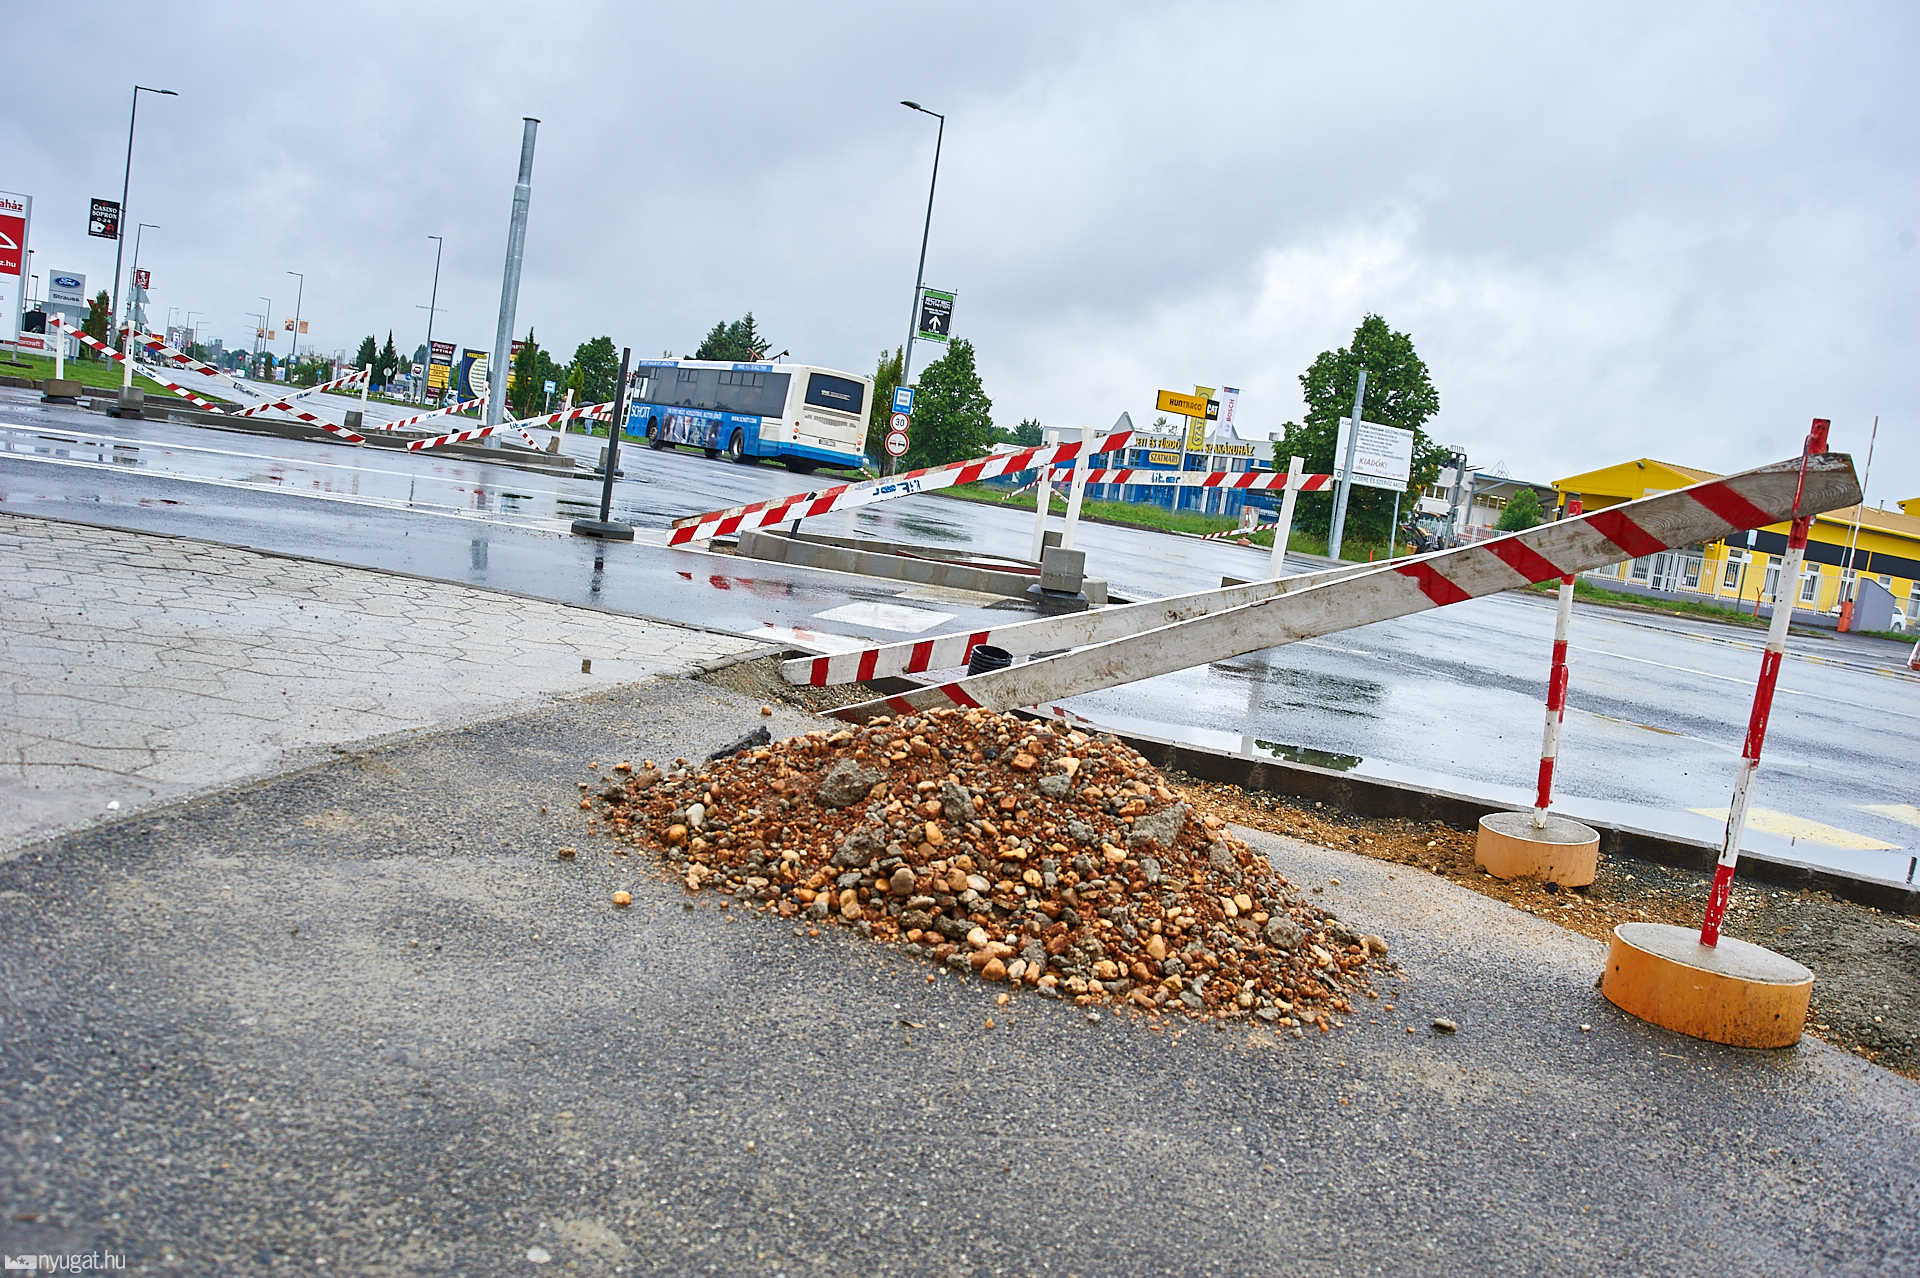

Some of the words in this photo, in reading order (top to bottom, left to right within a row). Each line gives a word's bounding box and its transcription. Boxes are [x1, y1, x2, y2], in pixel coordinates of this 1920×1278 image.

[93, 204, 118, 214] CASINO
[92, 210, 117, 220] SOPRON
[1206, 403, 1219, 416] CAT
[895, 417, 905, 427] 30
